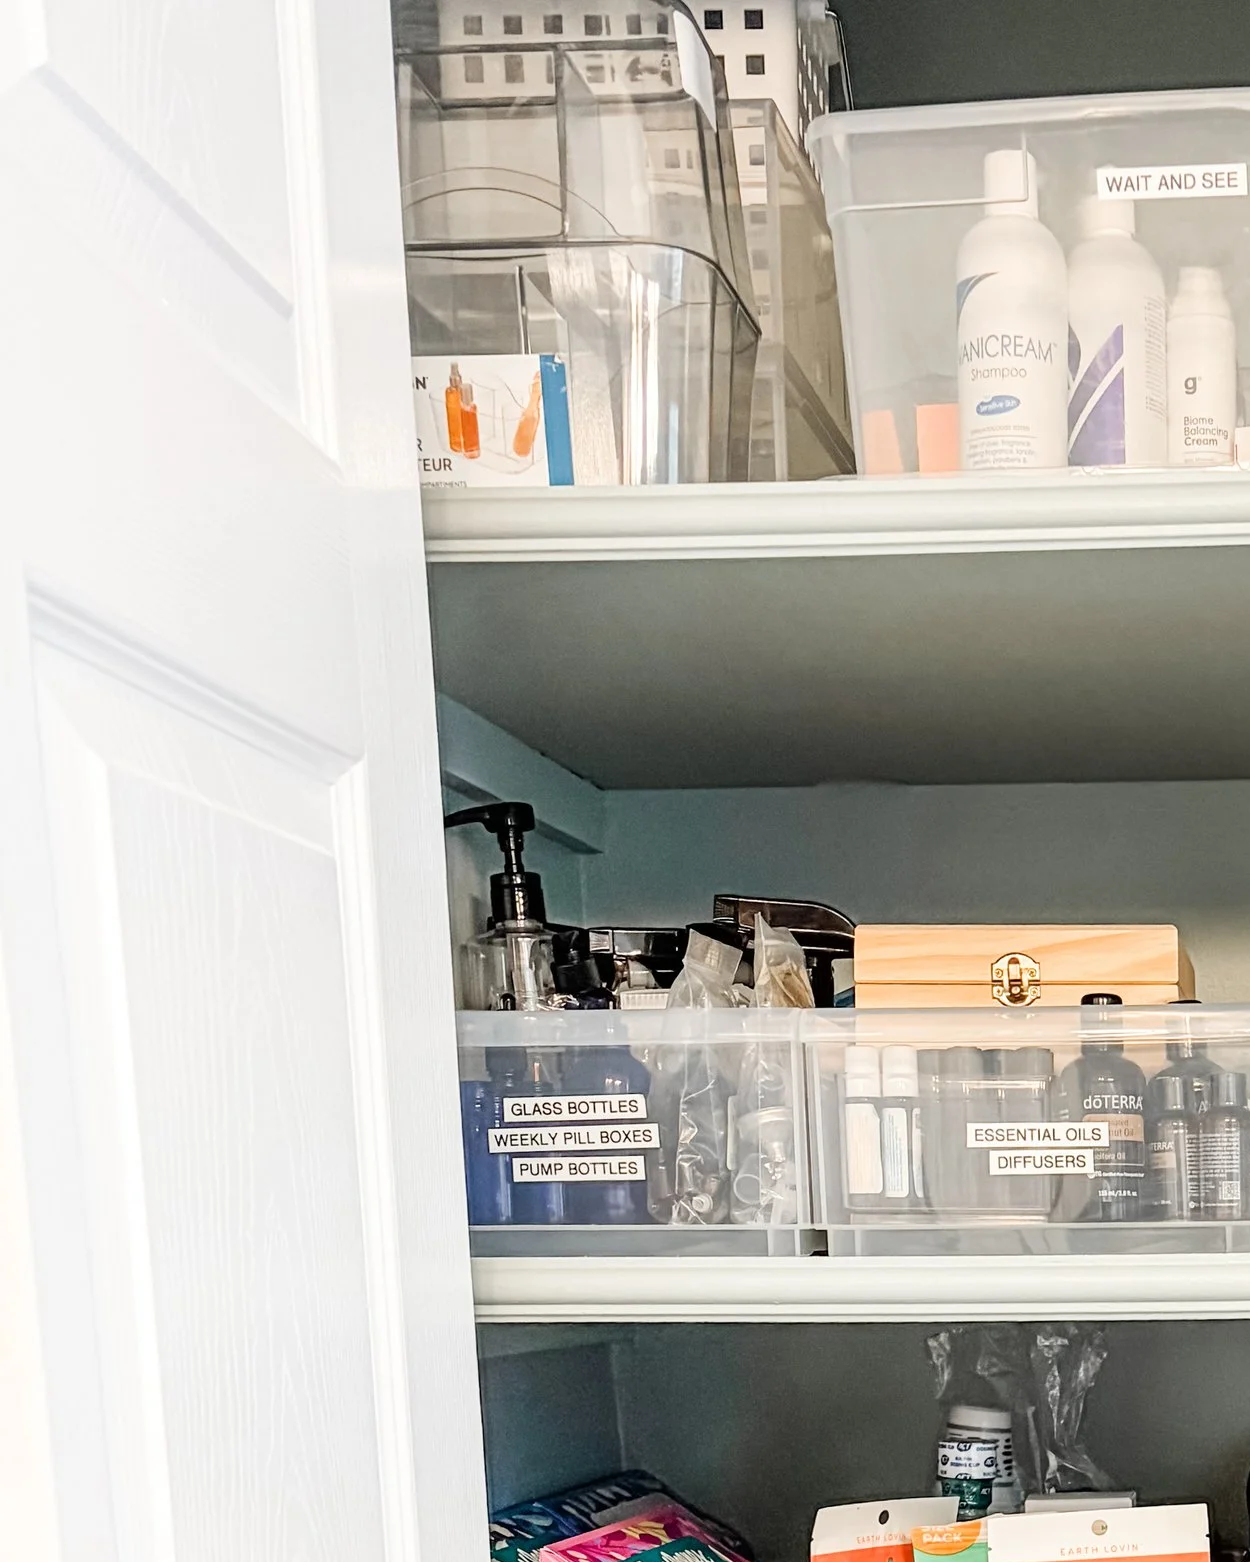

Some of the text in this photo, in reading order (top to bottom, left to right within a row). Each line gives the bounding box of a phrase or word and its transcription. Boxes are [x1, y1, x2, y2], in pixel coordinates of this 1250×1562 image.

[1105, 172, 1238, 192] WAIT AND SEE
[971, 367, 1027, 381] Shampoo
[1184, 376, 1198, 395] g
[1183, 416, 1214, 426] Biome
[1183, 426, 1229, 440] Balancing
[1183, 436, 1219, 447] Cream
[511, 1100, 639, 1116] GLASS BOTTLES
[494, 1130, 653, 1147] WEEKLY PILL BOXES
[974, 1127, 1101, 1142] ESSENTIAL OILS
[519, 1161, 639, 1176] PUMP BOTTLES
[998, 1155, 1087, 1169] DIFFUSERS
[856, 1535, 880, 1544] EARTH
[923, 1533, 961, 1543] PACK
[1060, 1546, 1098, 1556] EARTH
